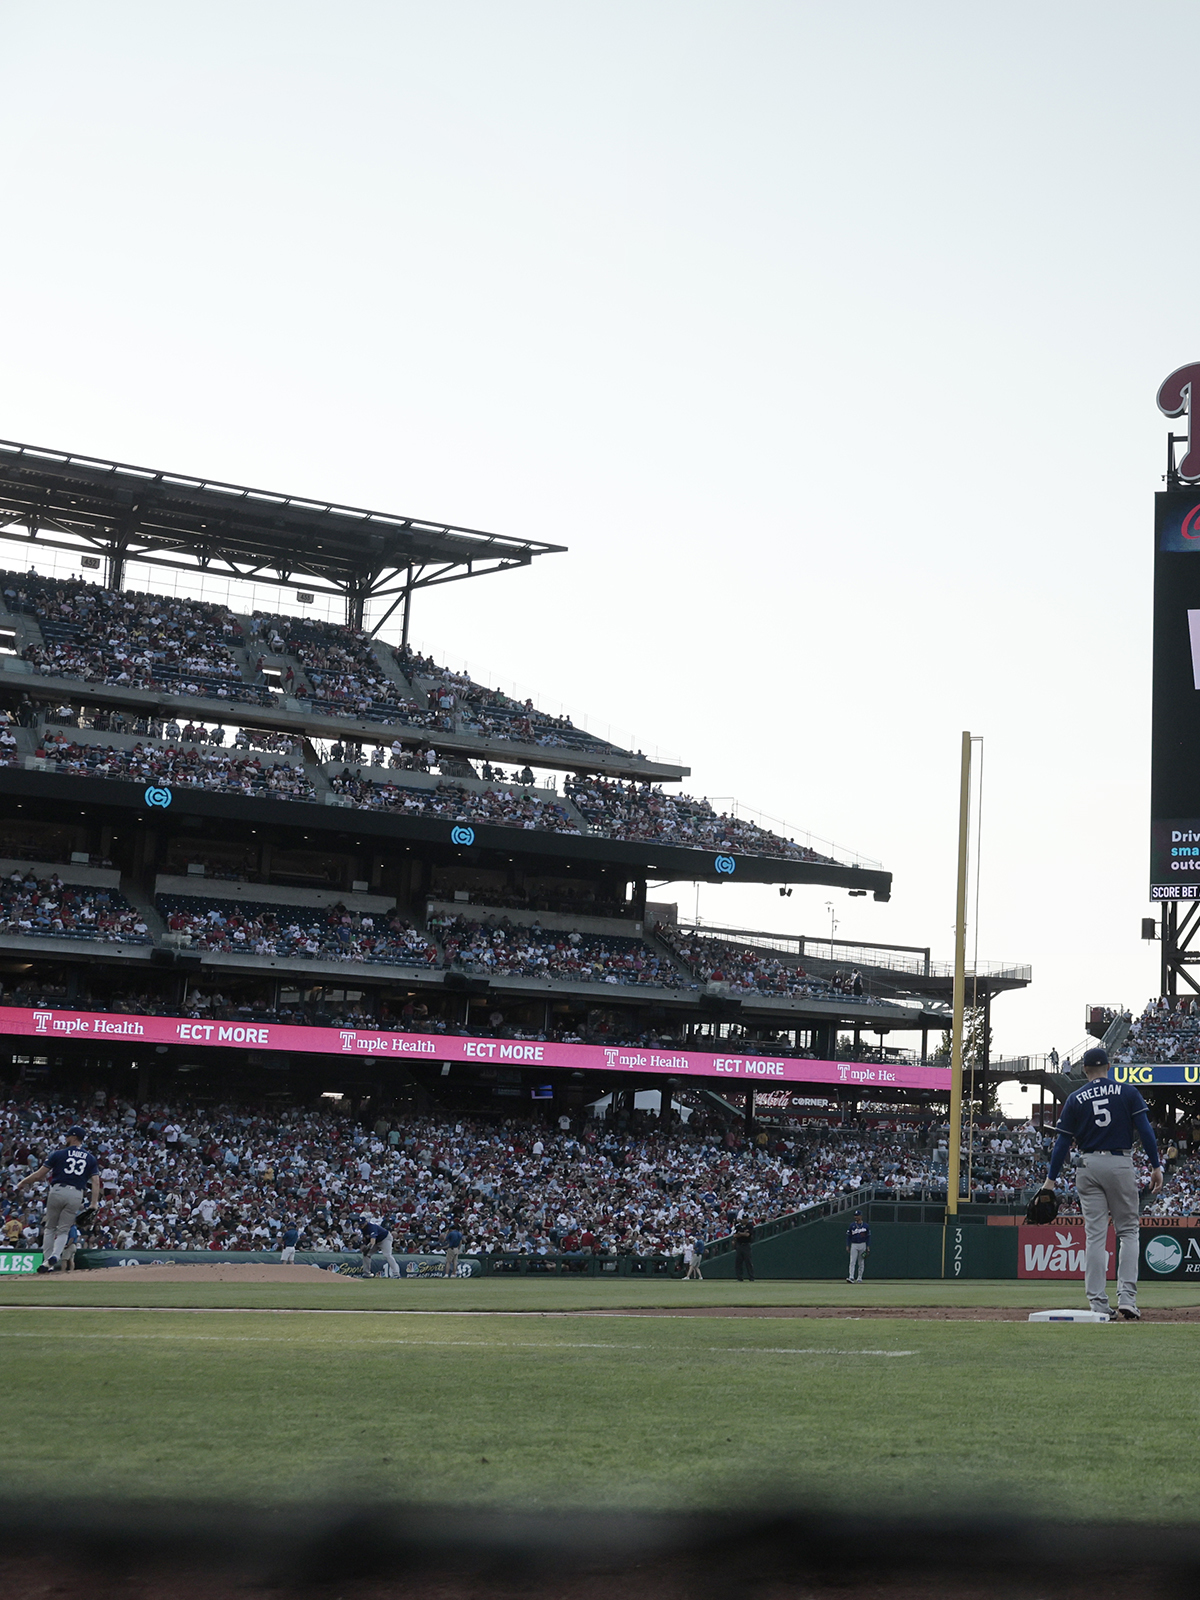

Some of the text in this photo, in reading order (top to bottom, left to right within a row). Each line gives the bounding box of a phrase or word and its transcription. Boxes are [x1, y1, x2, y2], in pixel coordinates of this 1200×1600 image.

[1152, 887, 1180, 898] SCORE
[1182, 886, 1199, 897] BET
[94, 1019, 144, 1036] Health
[176, 1024, 269, 1044] ECT MORE
[392, 1038, 436, 1053] Health
[464, 1042, 544, 1060] ECT MORE
[650, 1055, 689, 1069] Health
[713, 1059, 784, 1075] ECT MORE
[1114, 1067, 1153, 1083] UKG
[755, 1090, 829, 1107] oca-Cola CORNER
[1076, 1084, 1122, 1104] FREEMAN
[1092, 1099, 1112, 1127] 5
[63, 1157, 88, 1176] 33
[1022, 1217, 1084, 1226] ALUND
[1025, 1243, 1109, 1272] Waw
[339, 1262, 364, 1274] Sport
